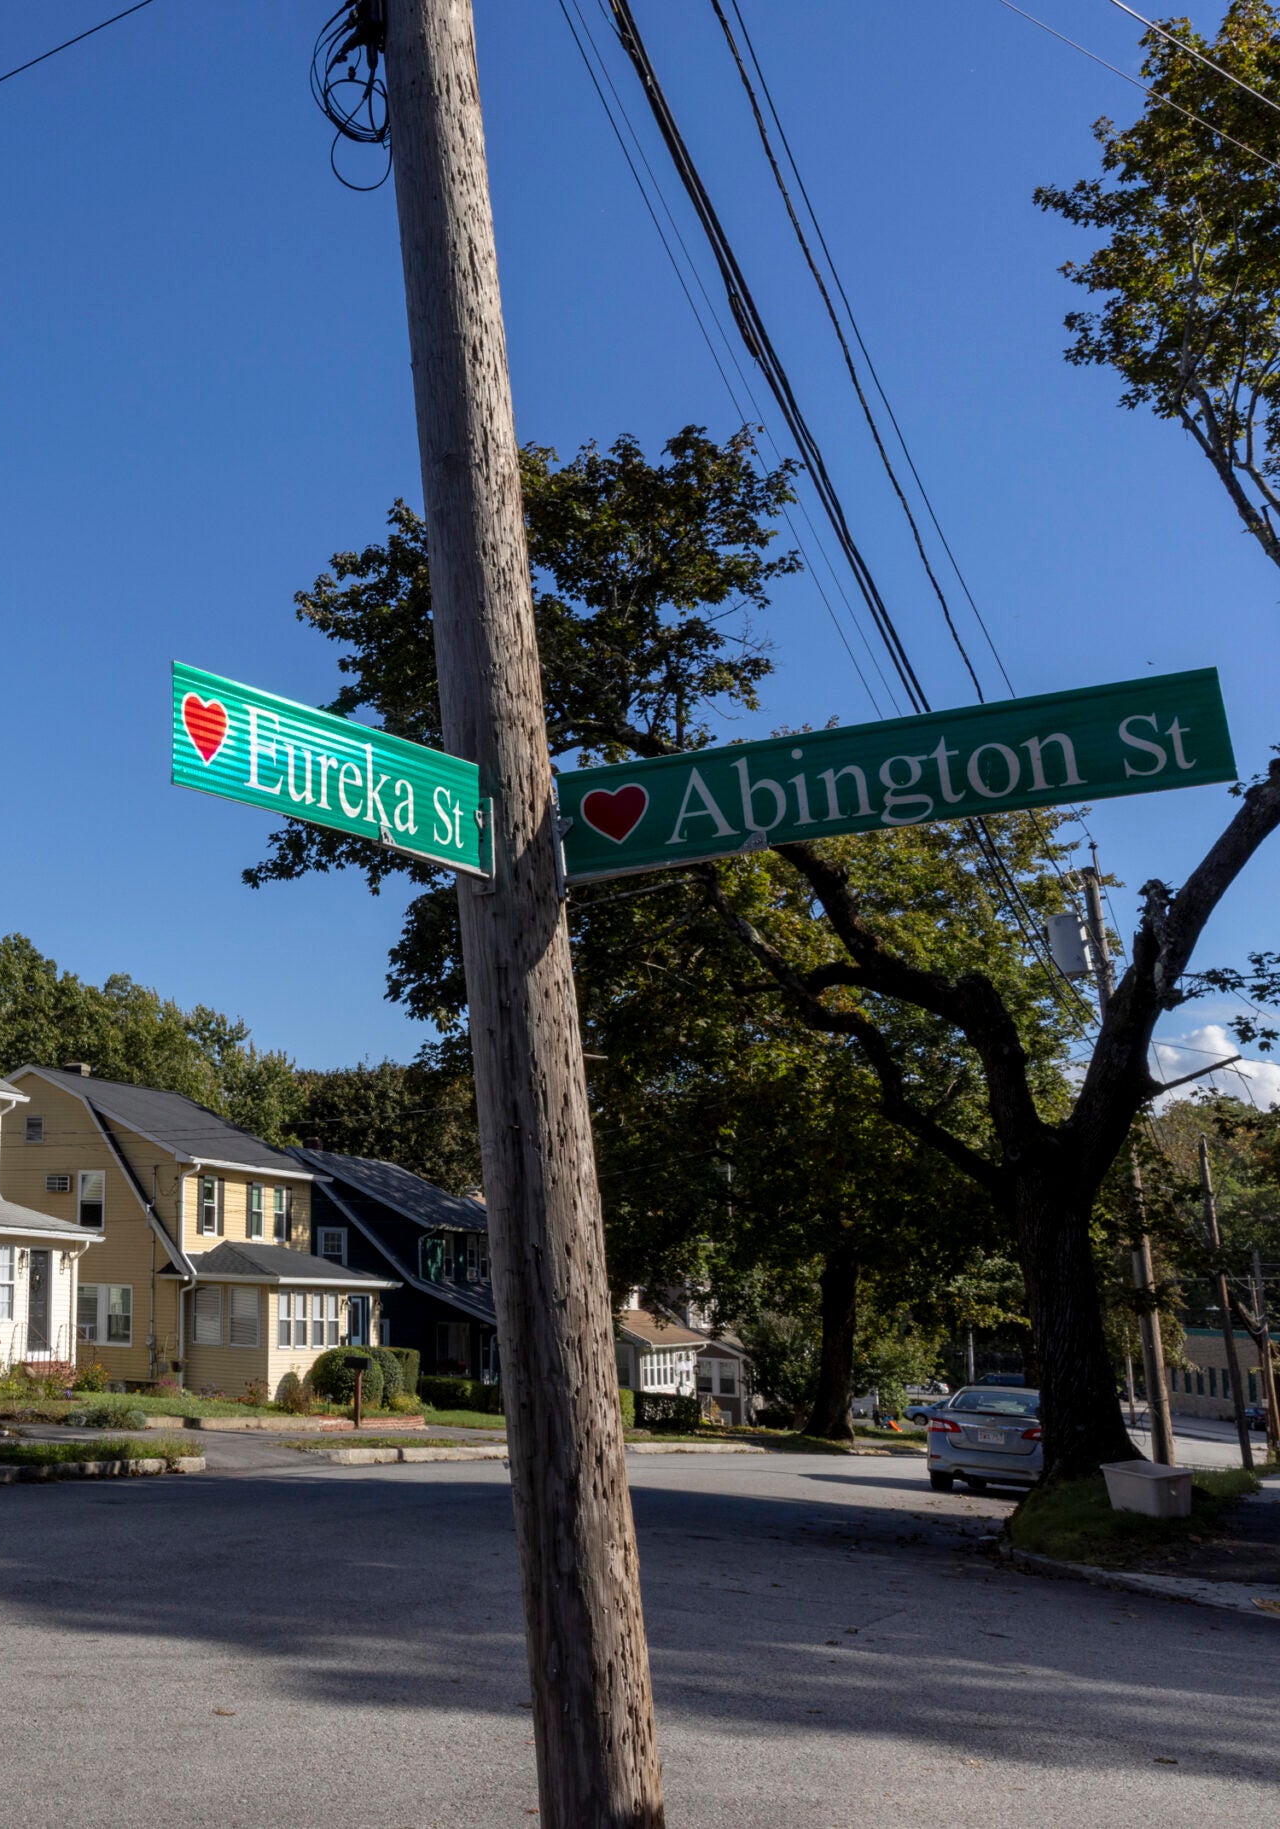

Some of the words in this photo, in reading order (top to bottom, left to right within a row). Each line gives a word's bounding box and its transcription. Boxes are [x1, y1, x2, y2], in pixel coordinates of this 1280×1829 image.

[242, 703, 418, 835] Eureka
[432, 786, 465, 849] St
[664, 731, 1089, 845] Abington
[1118, 711, 1197, 779] St
